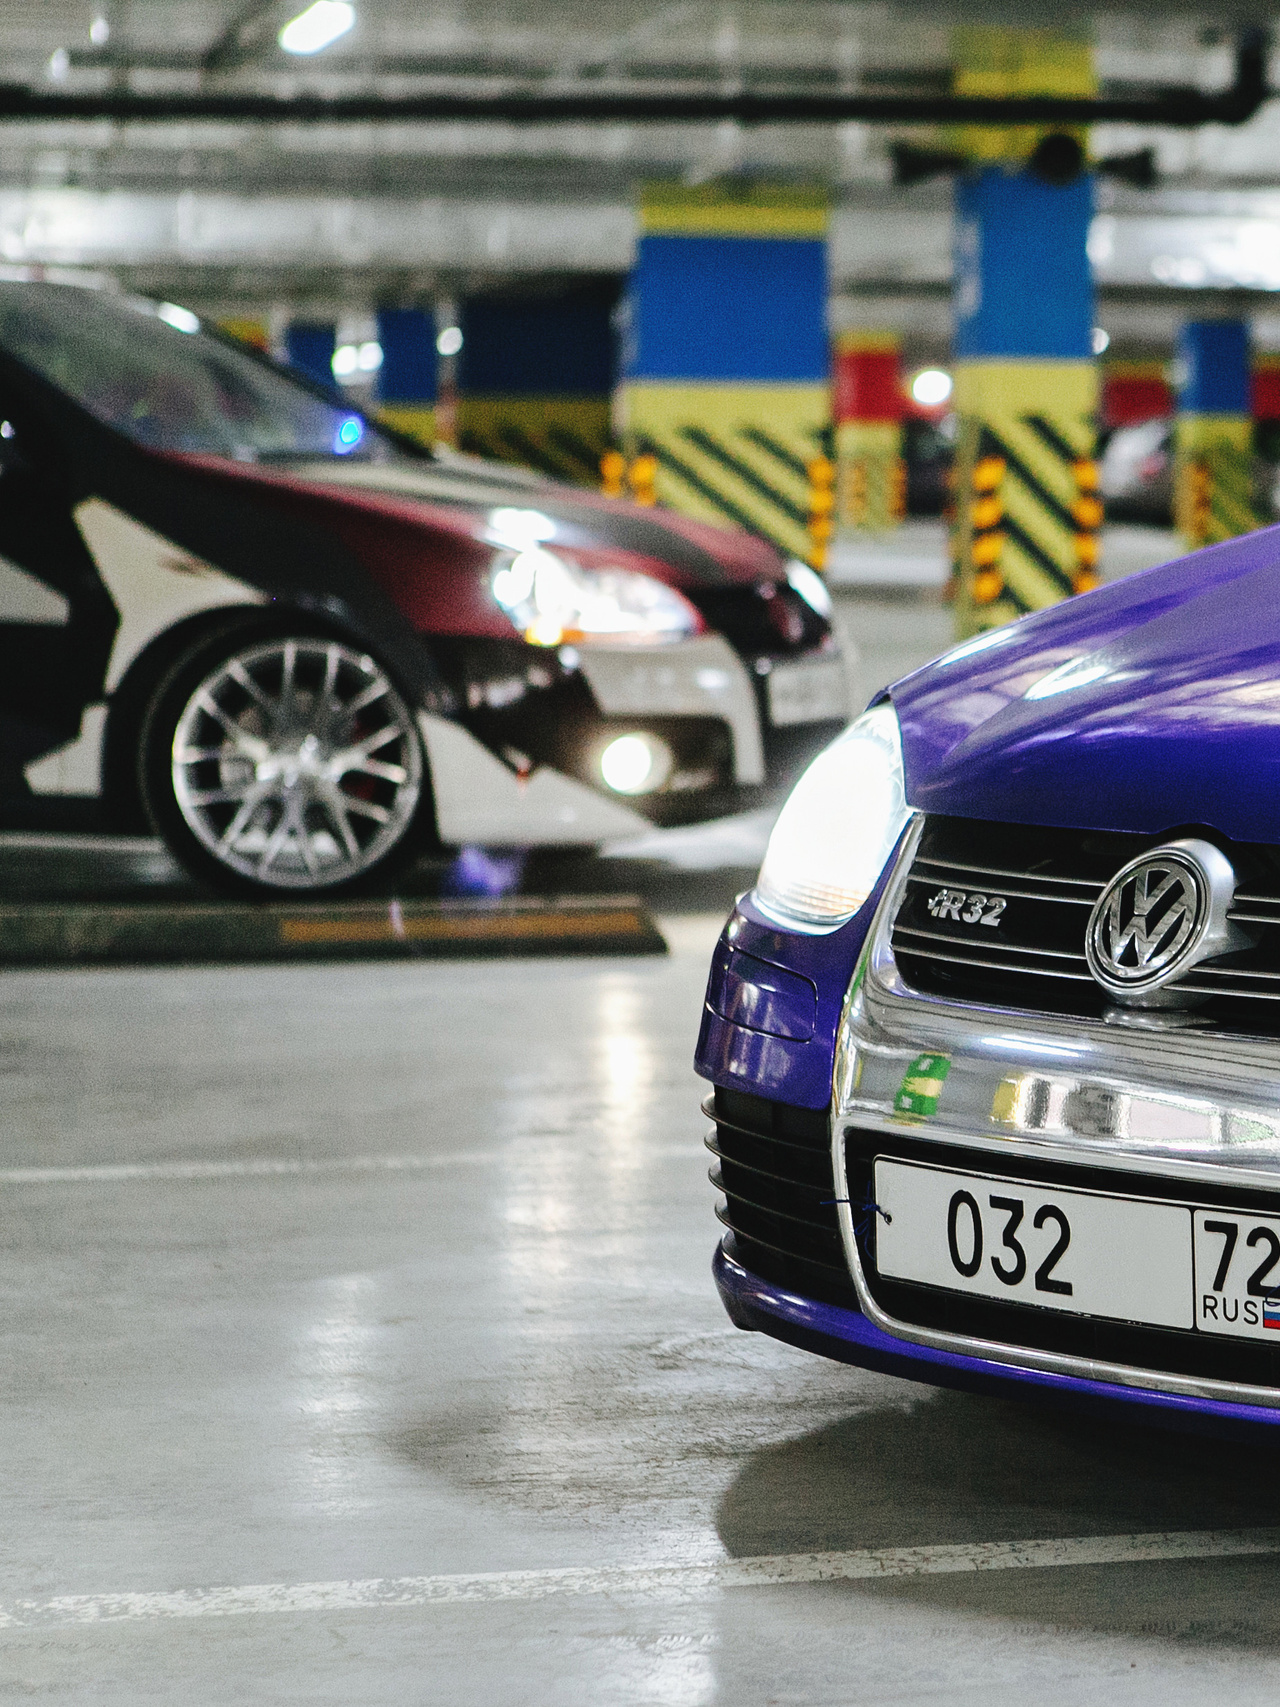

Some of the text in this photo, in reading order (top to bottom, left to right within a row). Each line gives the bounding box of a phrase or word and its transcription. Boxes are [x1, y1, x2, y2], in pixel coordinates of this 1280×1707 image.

[937, 890, 1008, 927] R32
[947, 1189, 1073, 1296] 032
[1202, 1294, 1260, 1326] RUS
